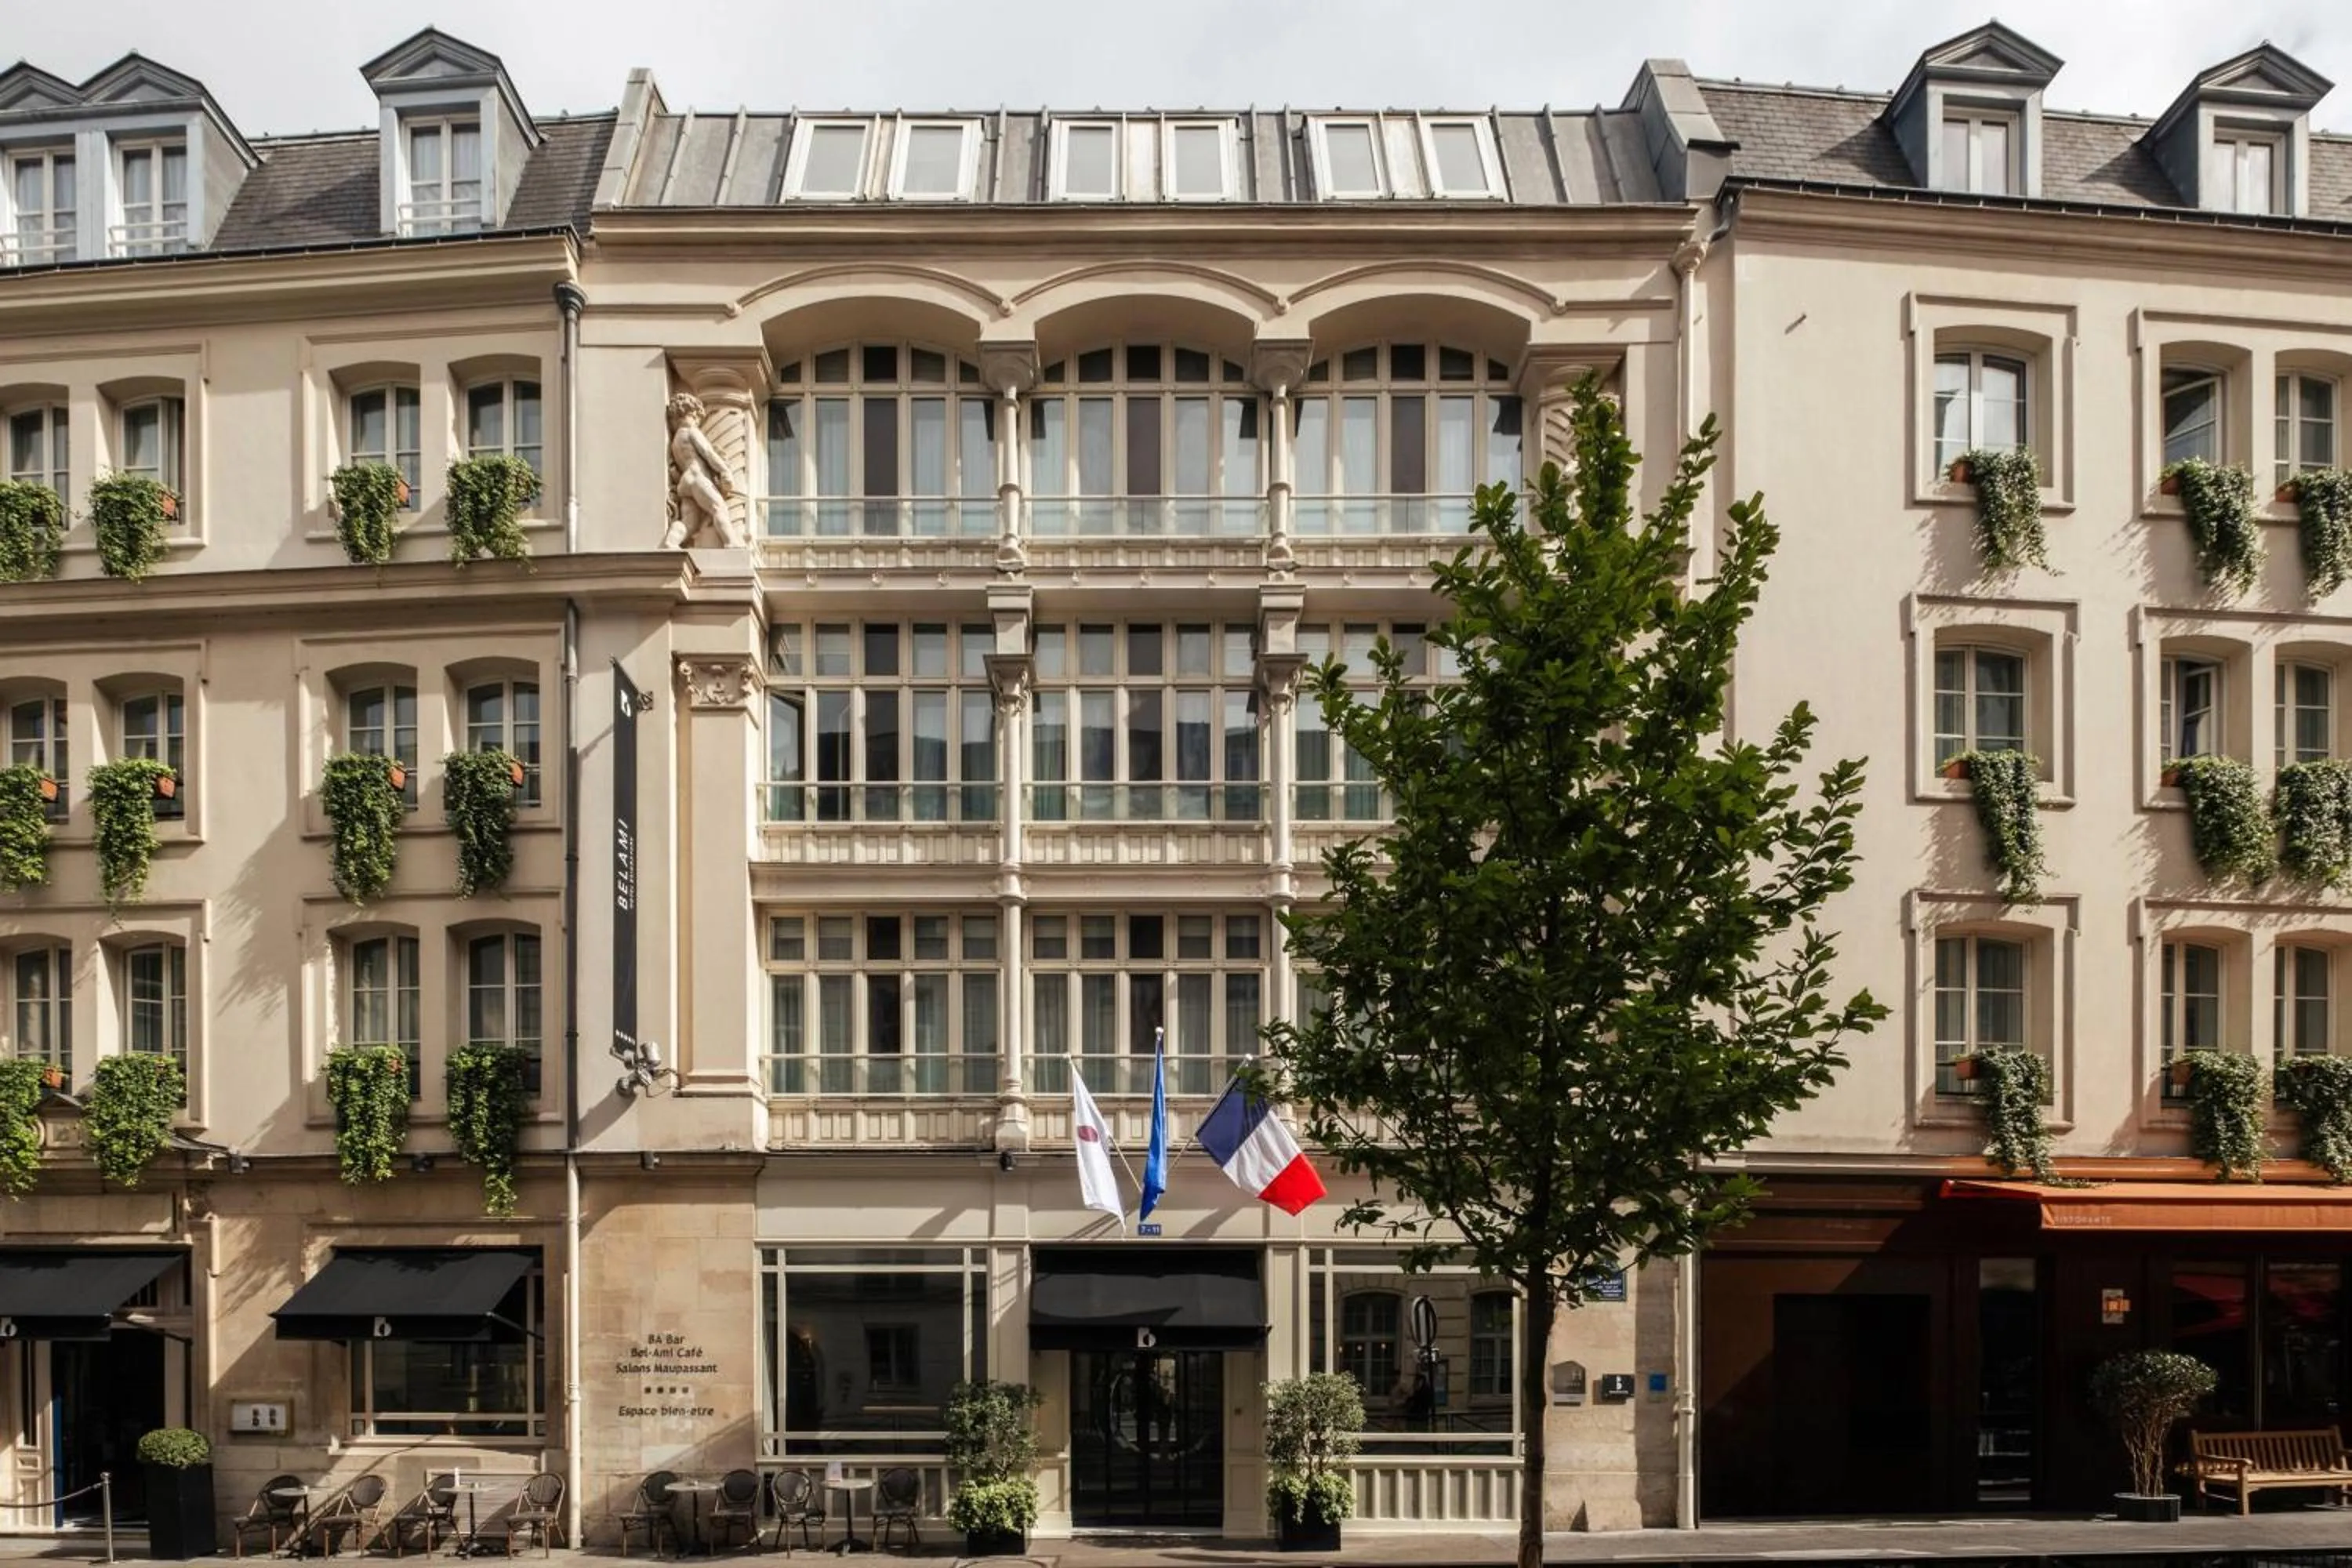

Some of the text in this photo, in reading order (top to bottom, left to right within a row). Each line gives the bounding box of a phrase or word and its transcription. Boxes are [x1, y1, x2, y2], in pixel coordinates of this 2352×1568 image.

[618, 818, 628, 910] BELAMI
[648, 1334, 685, 1345] BA Bar
[630, 1346, 702, 1358] Bel-Ami Café
[616, 1363, 717, 1374] Salons Maupassant
[619, 1406, 657, 1417] Espace
